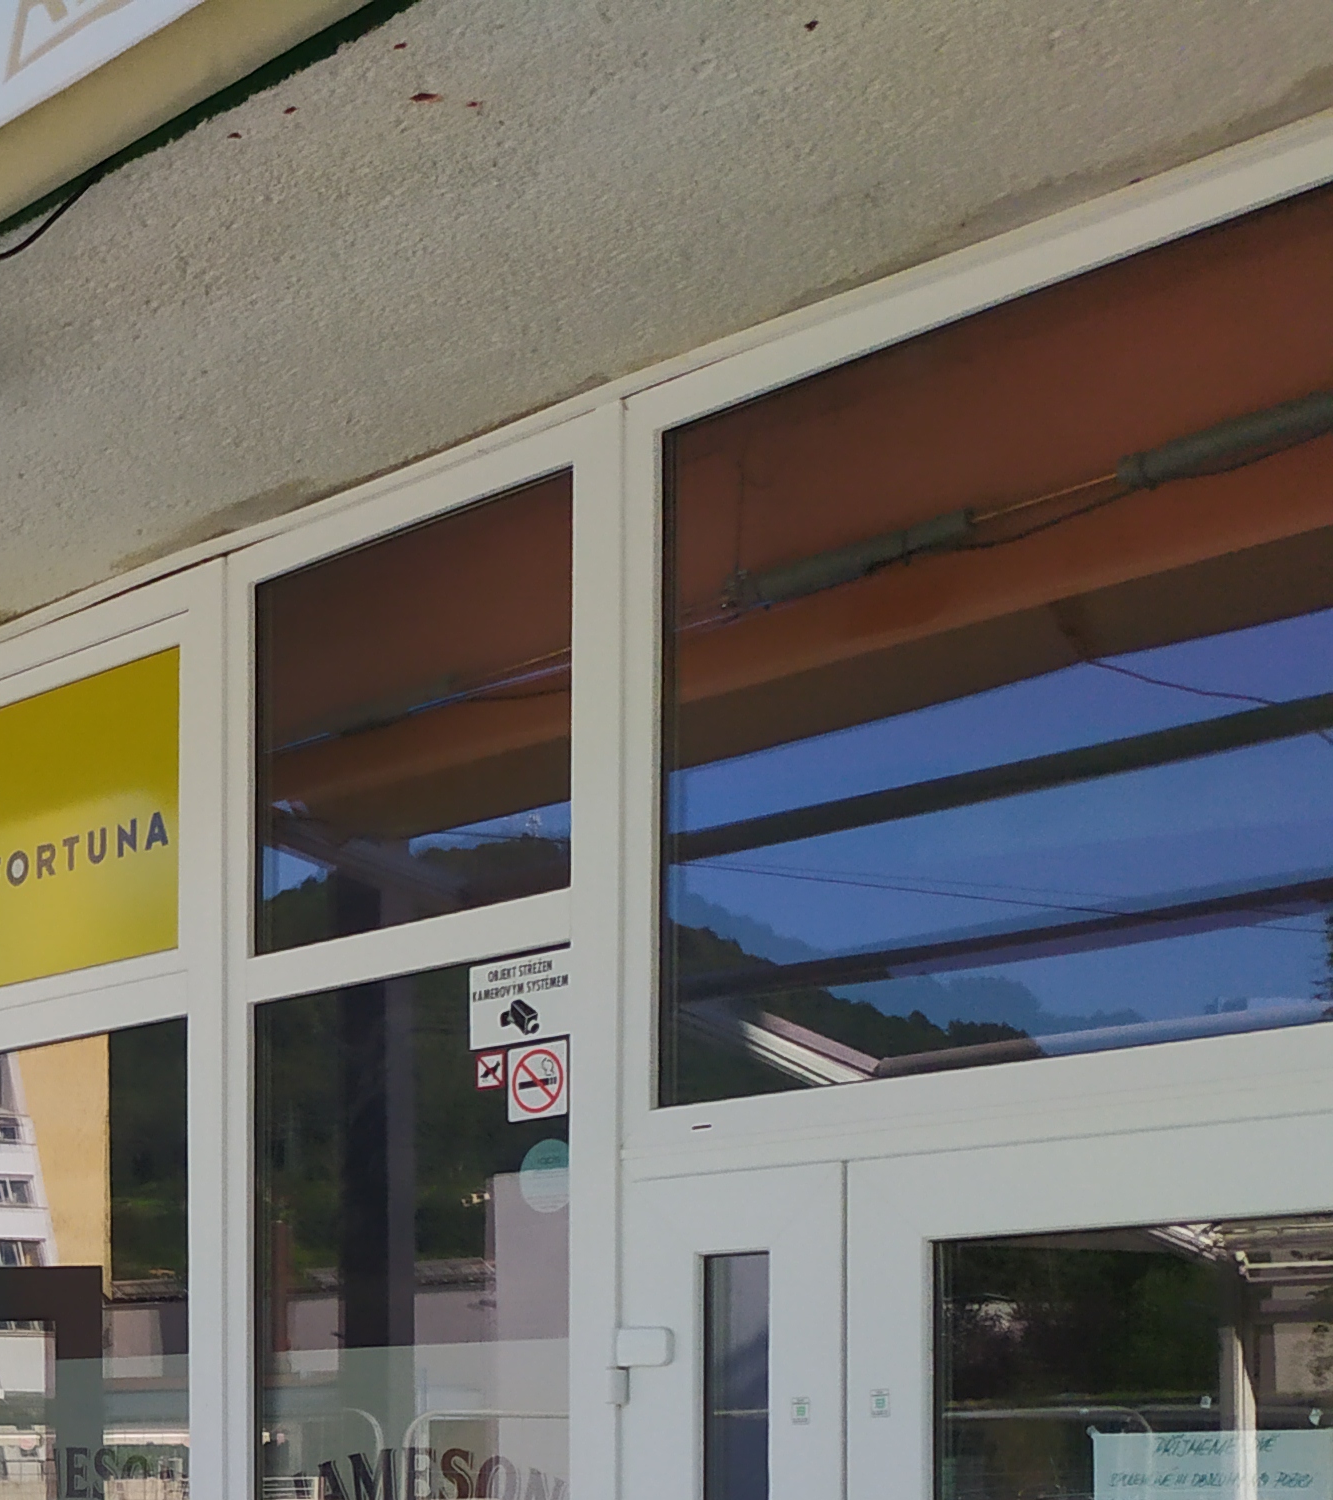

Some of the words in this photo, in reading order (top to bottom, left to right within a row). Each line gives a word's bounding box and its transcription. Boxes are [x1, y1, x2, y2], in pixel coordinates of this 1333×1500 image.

[487, 965, 517, 983] OBJEKT
[519, 958, 553, 978] STŘEŽEN
[472, 981, 524, 1003] KAMEROVÝM
[526, 973, 569, 993] SYSTÉMEM
